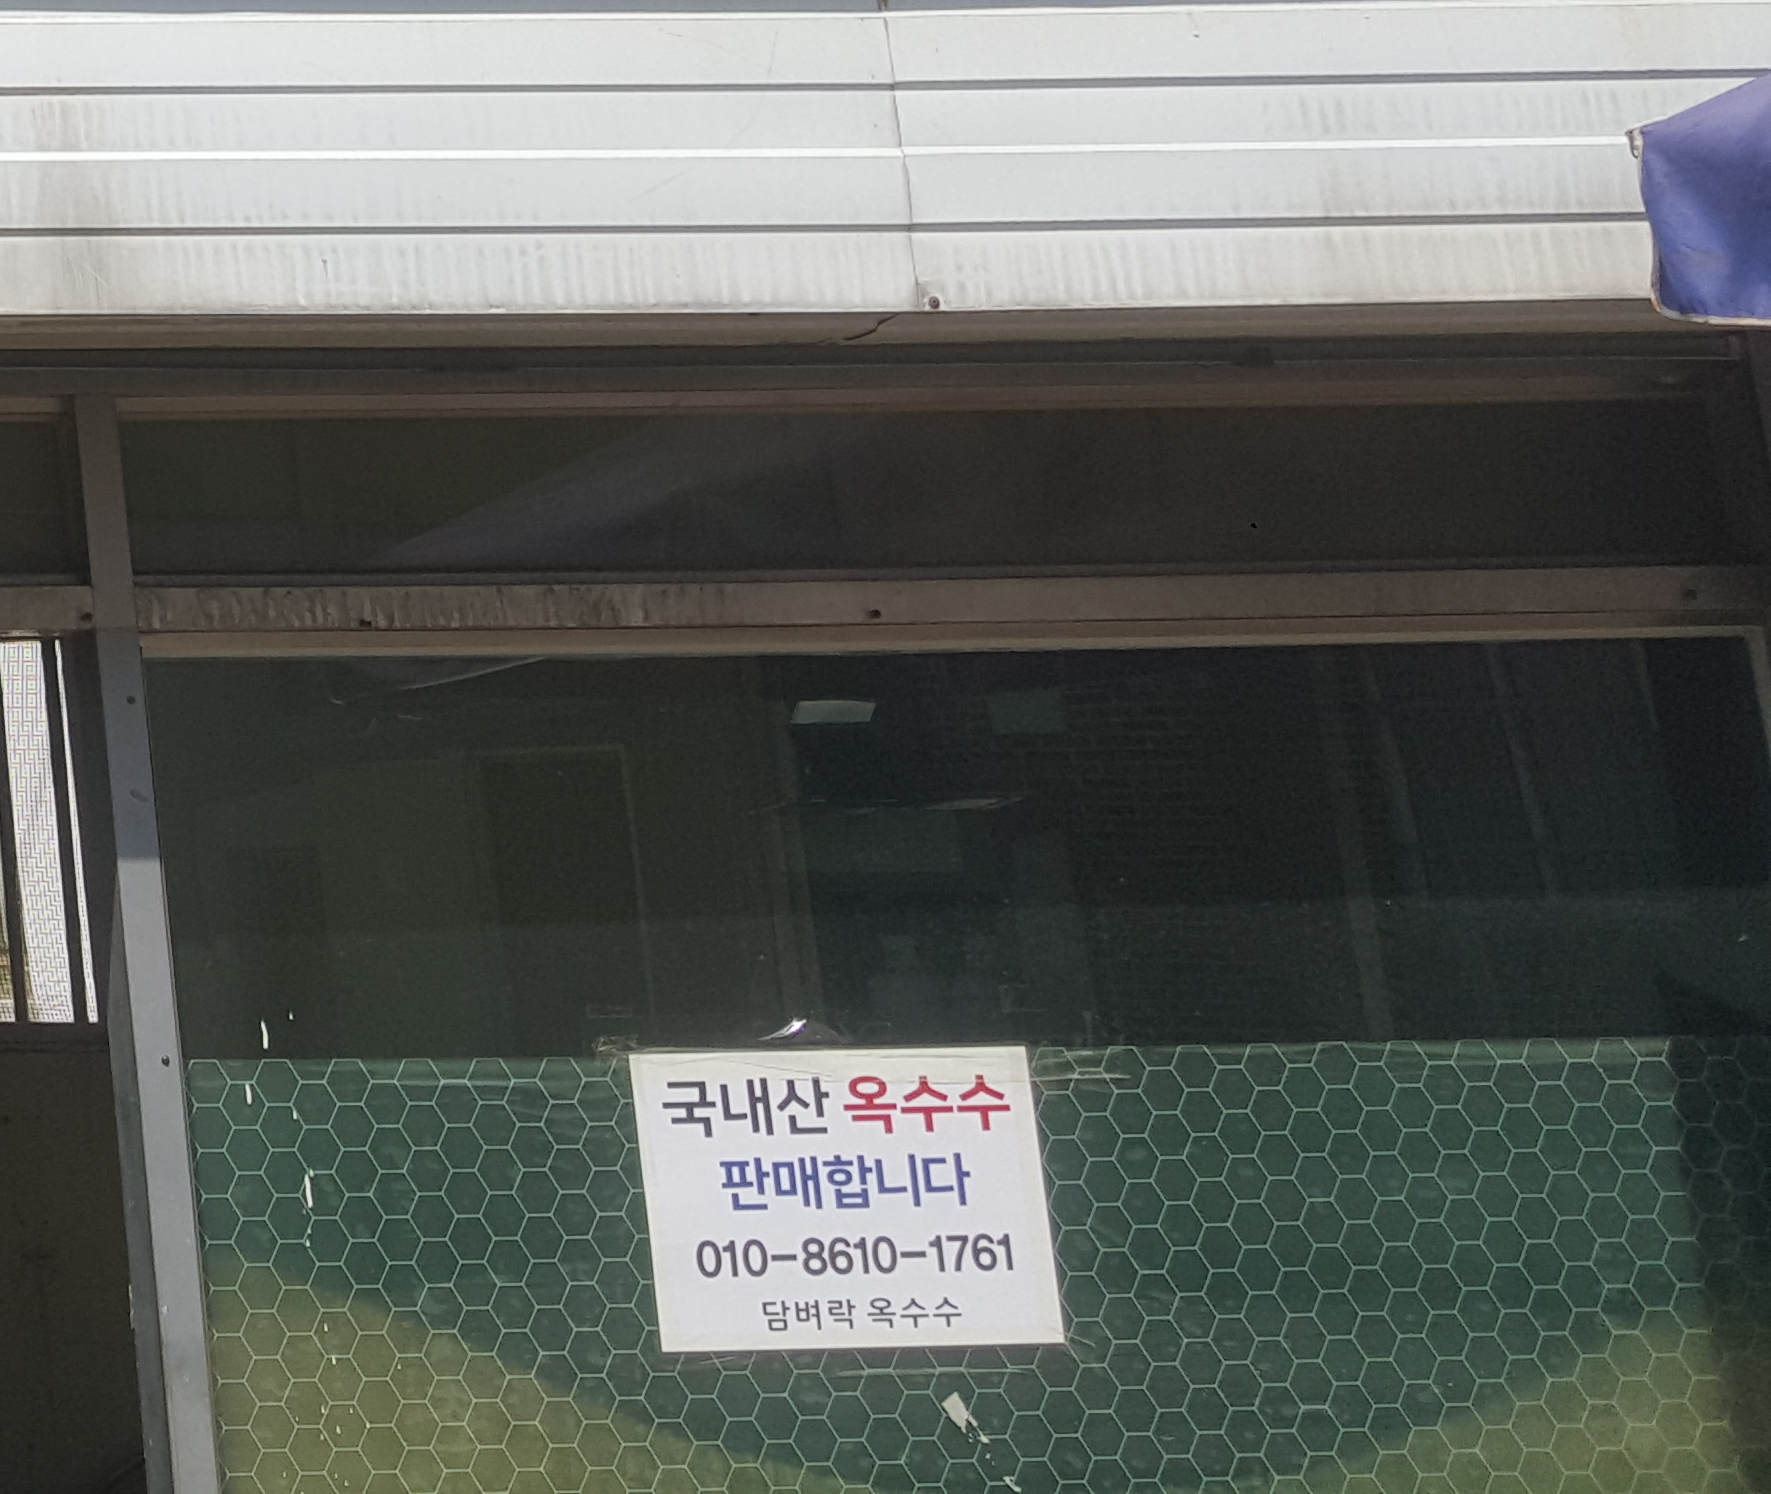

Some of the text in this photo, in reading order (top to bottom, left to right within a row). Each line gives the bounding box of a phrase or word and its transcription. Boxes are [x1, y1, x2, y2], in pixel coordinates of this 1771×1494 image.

[662, 1074, 1011, 1137] 국내산 옥수수
[719, 1153, 970, 1212] 판매합니다
[696, 1233, 1014, 1278] 010-8610-1761
[762, 1297, 962, 1332] 담벼락 옥수수
